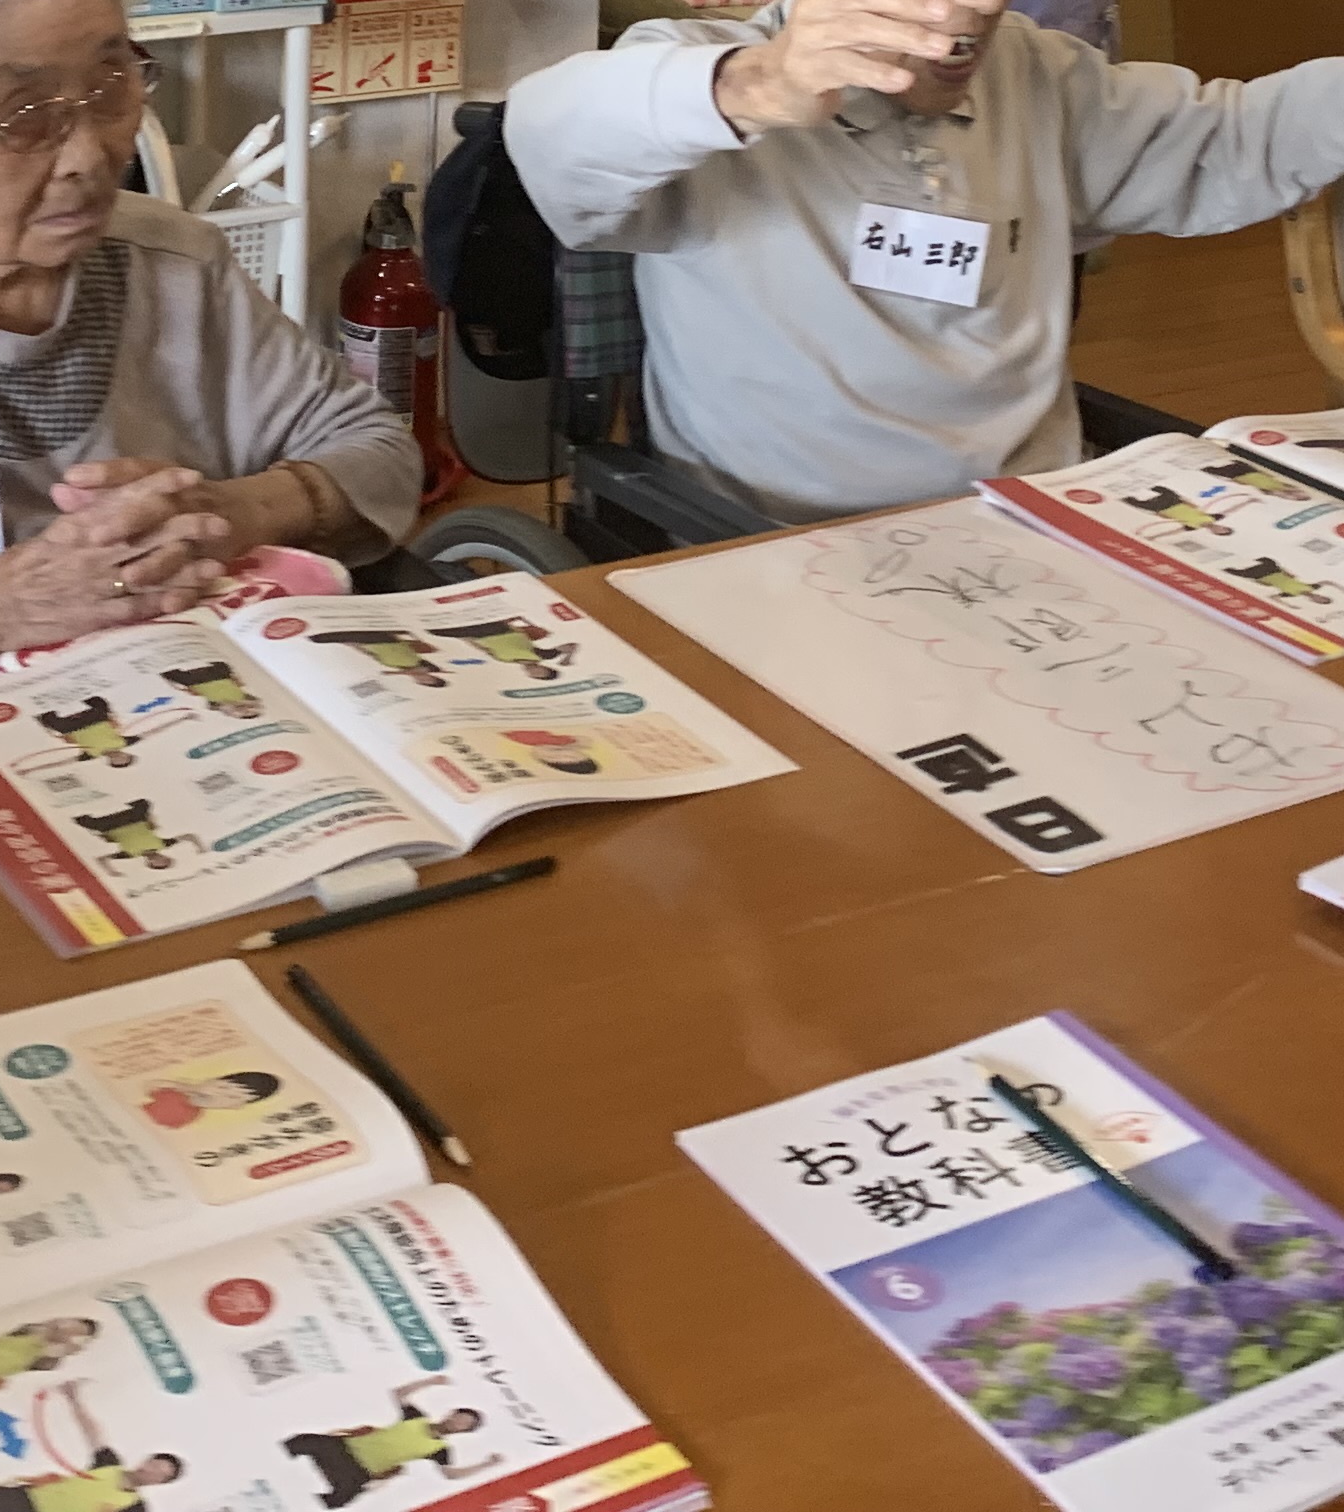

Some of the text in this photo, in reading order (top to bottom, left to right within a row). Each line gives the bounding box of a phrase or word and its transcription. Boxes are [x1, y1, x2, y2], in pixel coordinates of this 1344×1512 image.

[778, 1080, 1065, 1186] おとなの
[853, 1128, 1084, 1229] 教科書
